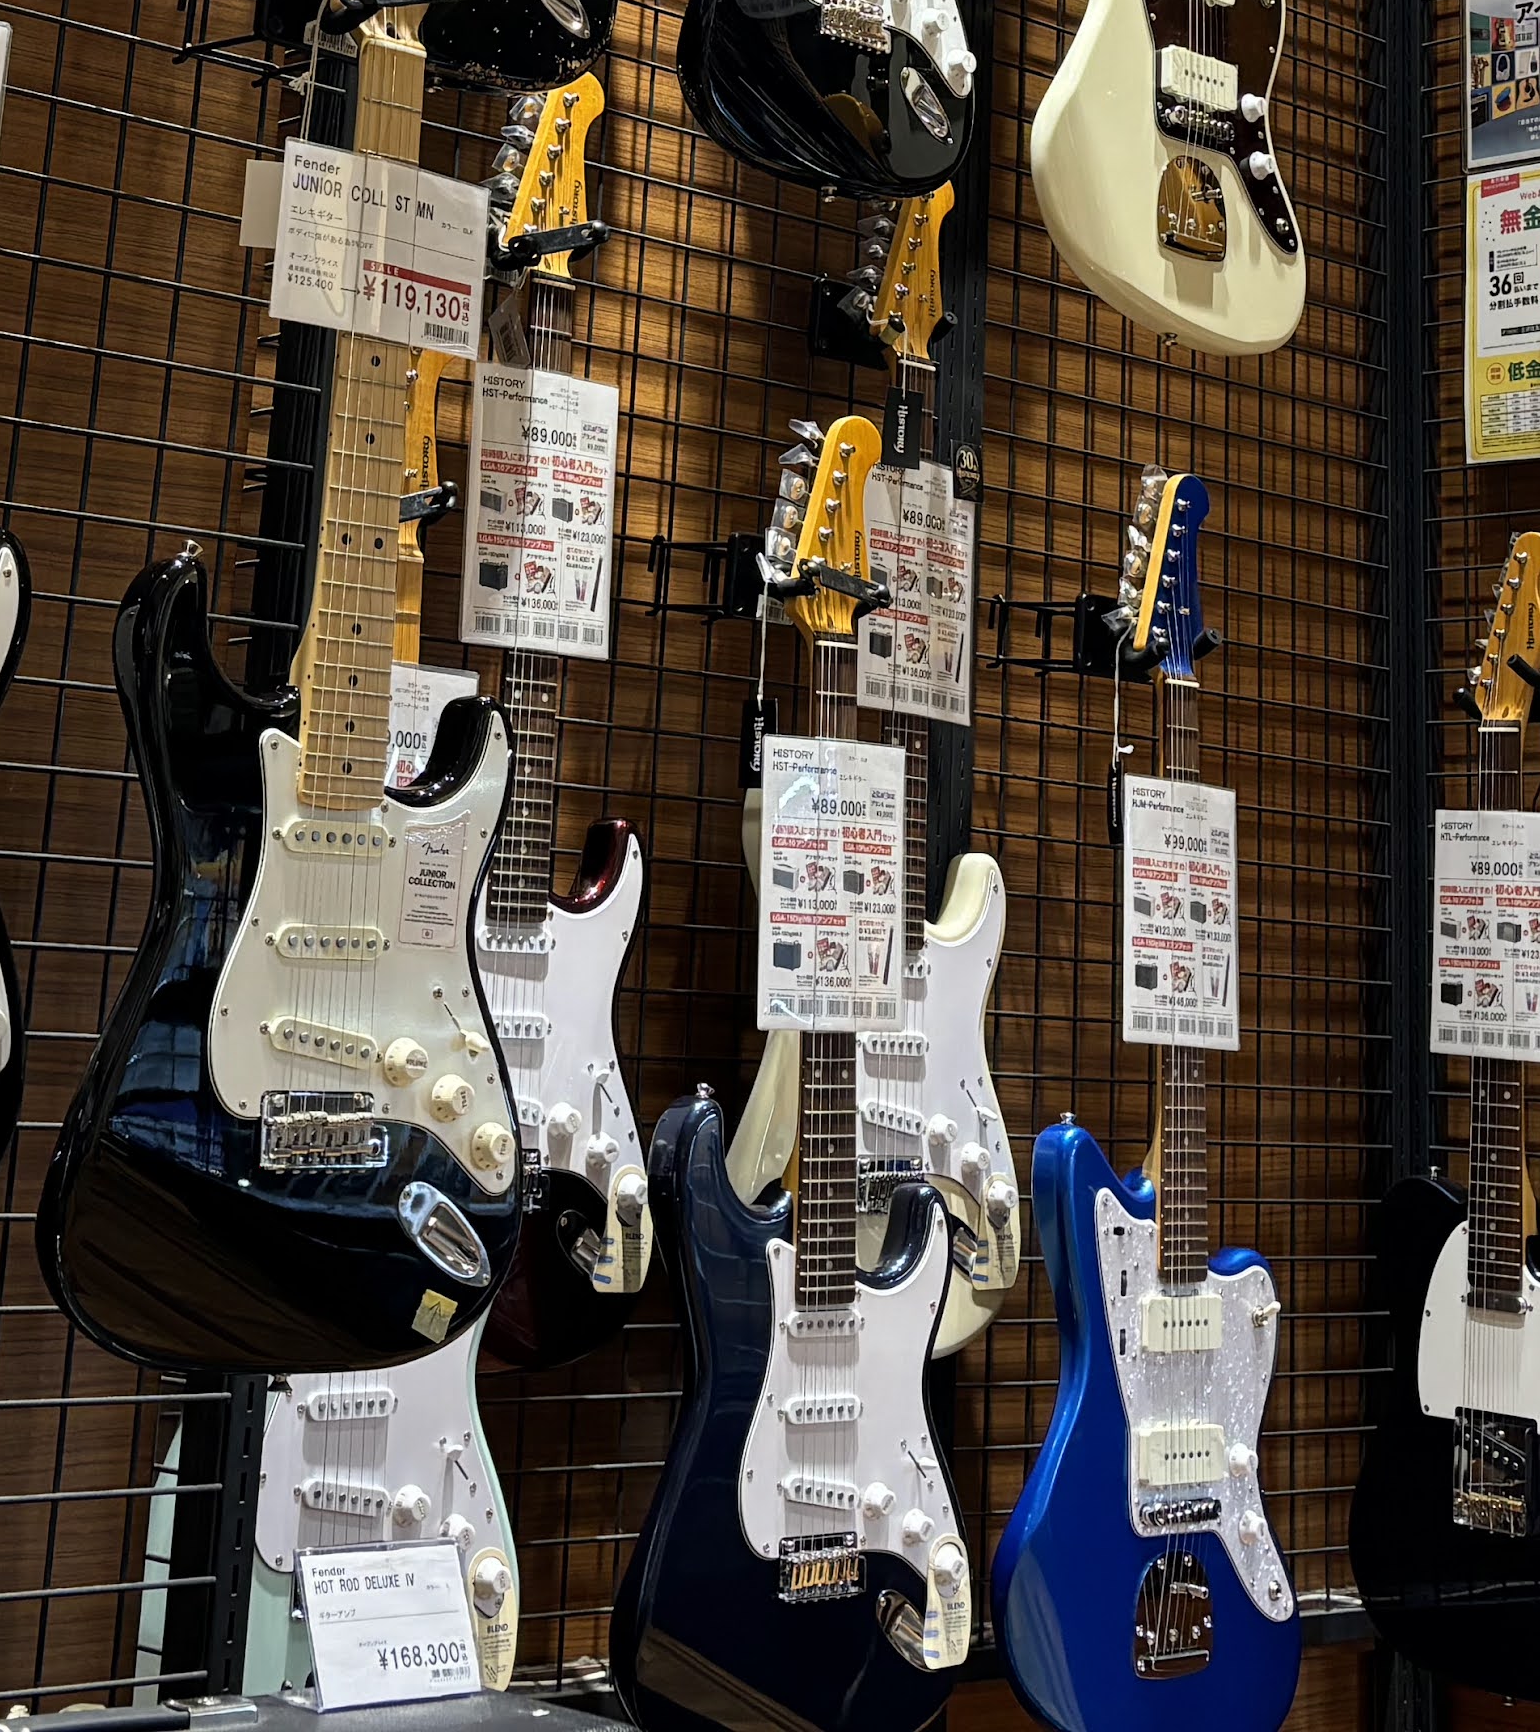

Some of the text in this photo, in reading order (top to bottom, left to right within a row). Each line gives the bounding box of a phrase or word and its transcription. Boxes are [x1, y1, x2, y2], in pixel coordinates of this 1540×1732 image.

[294, 155, 341, 175] Fender
[292, 173, 434, 220] JUNIOR COLL ST MN
[290, 204, 343, 222] エレキギター
[370, 261, 400, 277] SALE
[363, 274, 461, 321] ¥119,130
[1489, 295, 1539, 311] 分割払手数料
[483, 374, 526, 389] HISTORY
[521, 424, 574, 449] ¥89,000
[893, 404, 909, 454] HISTORY
[903, 508, 946, 529] ¥89,000
[812, 795, 864, 820] ¥89,000
[1164, 833, 1204, 855] ¥99,000
[418, 868, 446, 879] JUNIOR
[1471, 860, 1518, 878] ¥89,000
[408, 876, 456, 890] COLLECTION
[312, 1566, 345, 1578] Fender
[314, 1580, 334, 1595] HOT
[340, 1578, 360, 1593] ROD
[365, 1575, 400, 1591] DELUXE
[486, 1622, 509, 1635] BLEND
[377, 1640, 460, 1671] ¥168,300
